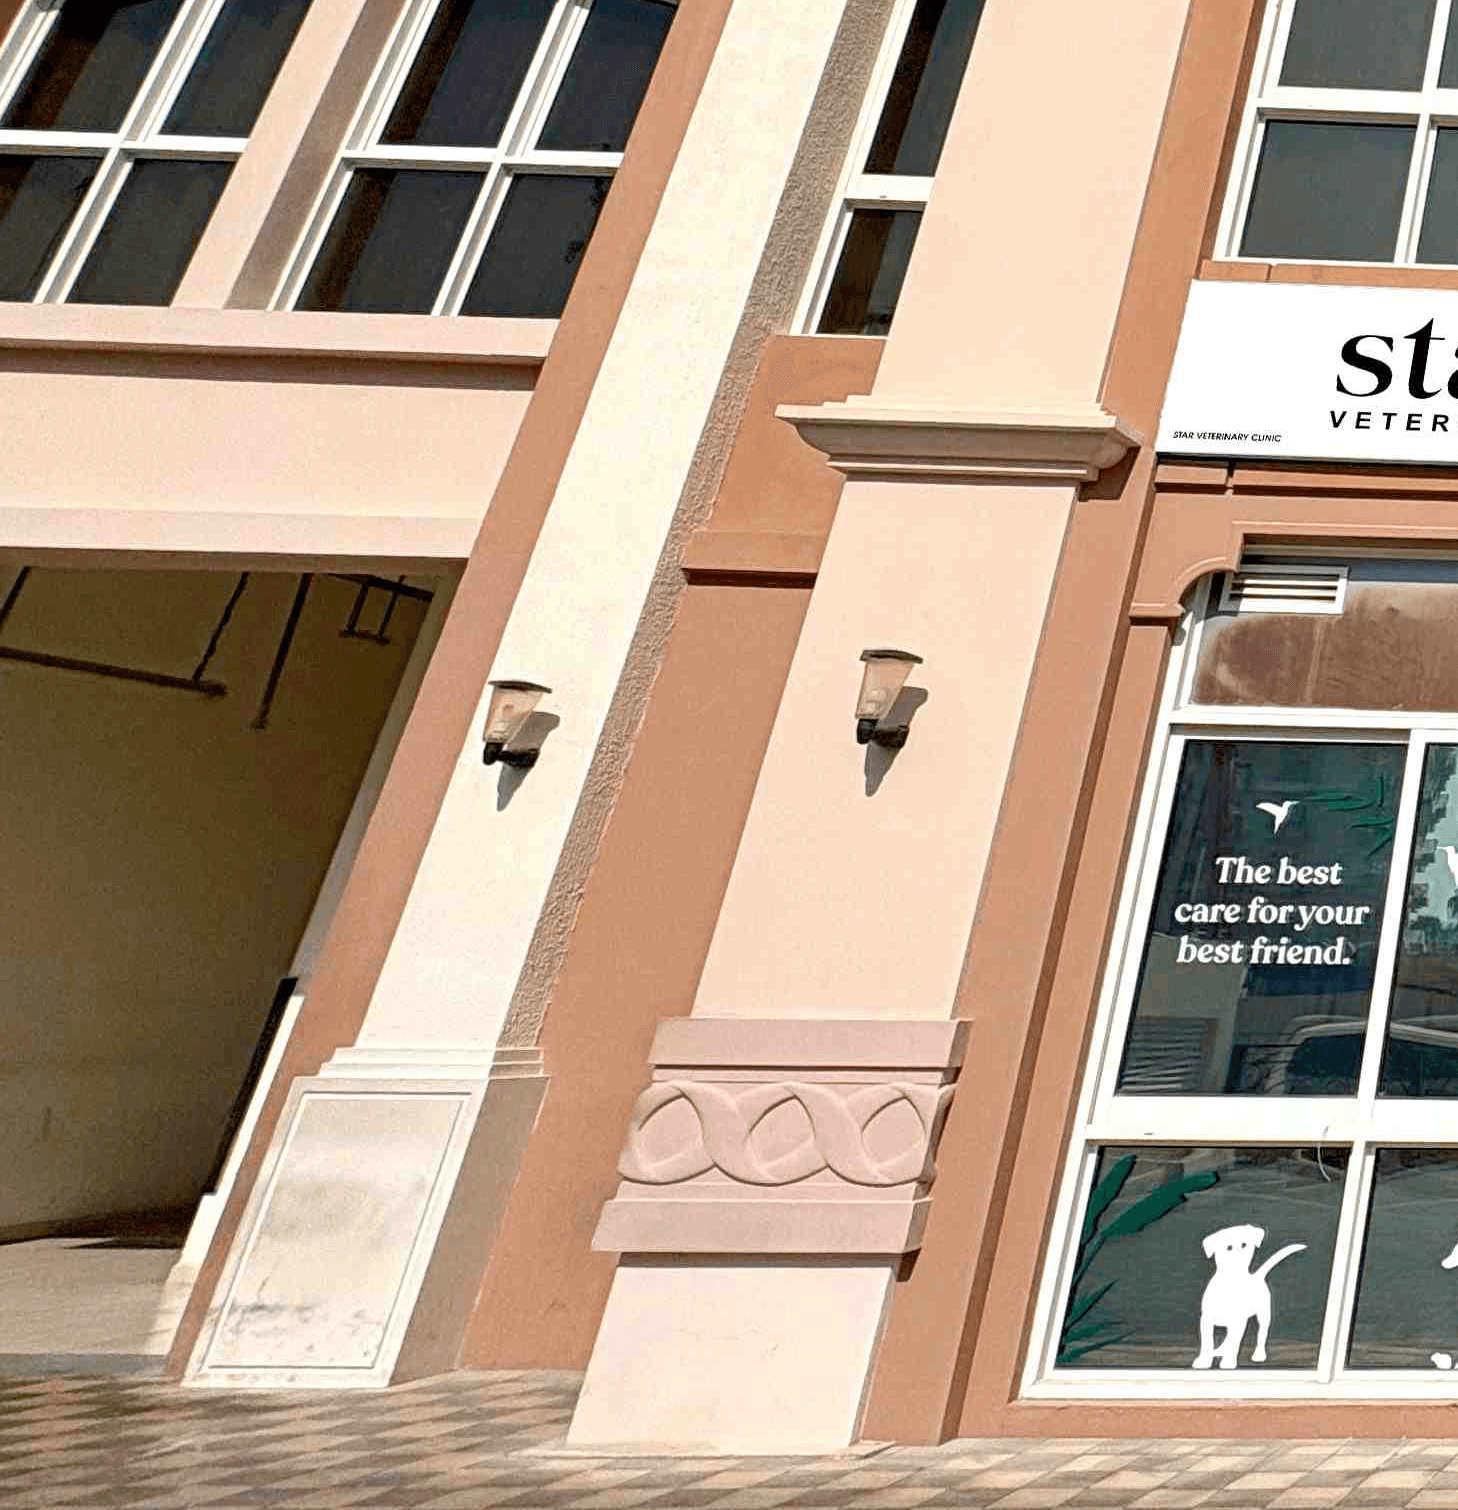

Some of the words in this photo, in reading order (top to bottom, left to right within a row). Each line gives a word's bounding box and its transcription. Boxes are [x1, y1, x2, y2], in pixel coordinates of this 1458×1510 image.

[1172, 430, 1195, 439] STAR
[1196, 431, 1250, 441] VETERINARY
[1250, 433, 1282, 443] CLINIC
[1216, 857, 1271, 883] The
[1277, 857, 1342, 884] best
[1175, 904, 1240, 923] care
[1247, 896, 1294, 923] for
[1294, 906, 1370, 930] your
[1176, 935, 1244, 963] best
[1250, 936, 1350, 964] friend.
